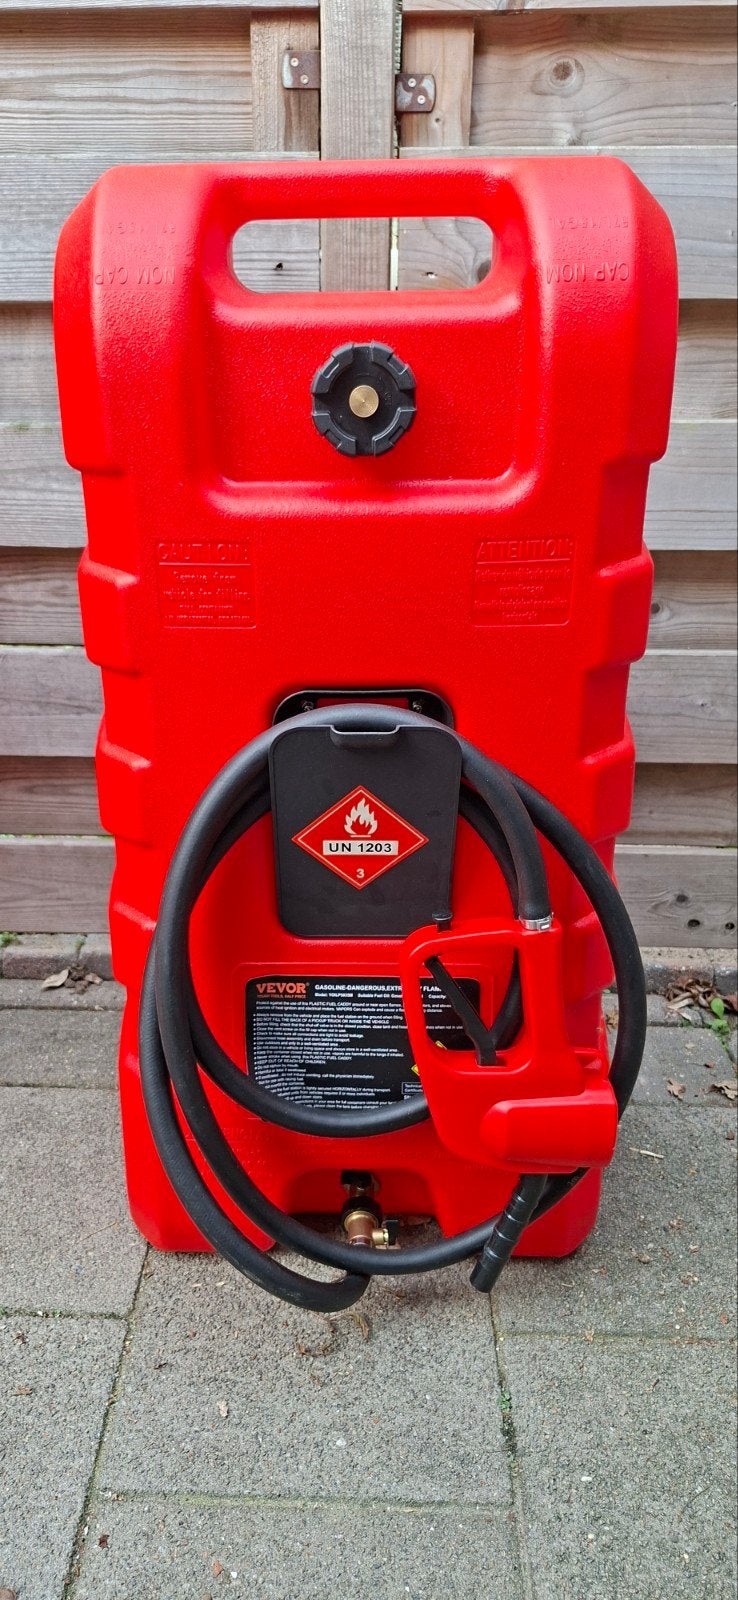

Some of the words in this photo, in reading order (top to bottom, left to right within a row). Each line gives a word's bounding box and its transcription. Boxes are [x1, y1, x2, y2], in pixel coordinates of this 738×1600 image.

[94, 266, 129, 285] CAP
[137, 266, 175, 285] NOM
[546, 263, 586, 285] NOM
[594, 262, 630, 282] CAP
[476, 538, 573, 559] ATTENTION:
[328, 842, 352, 853] UN
[357, 842, 392, 853] 1203
[356, 868, 365, 879] 3
[256, 982, 306, 994] VEVOR
